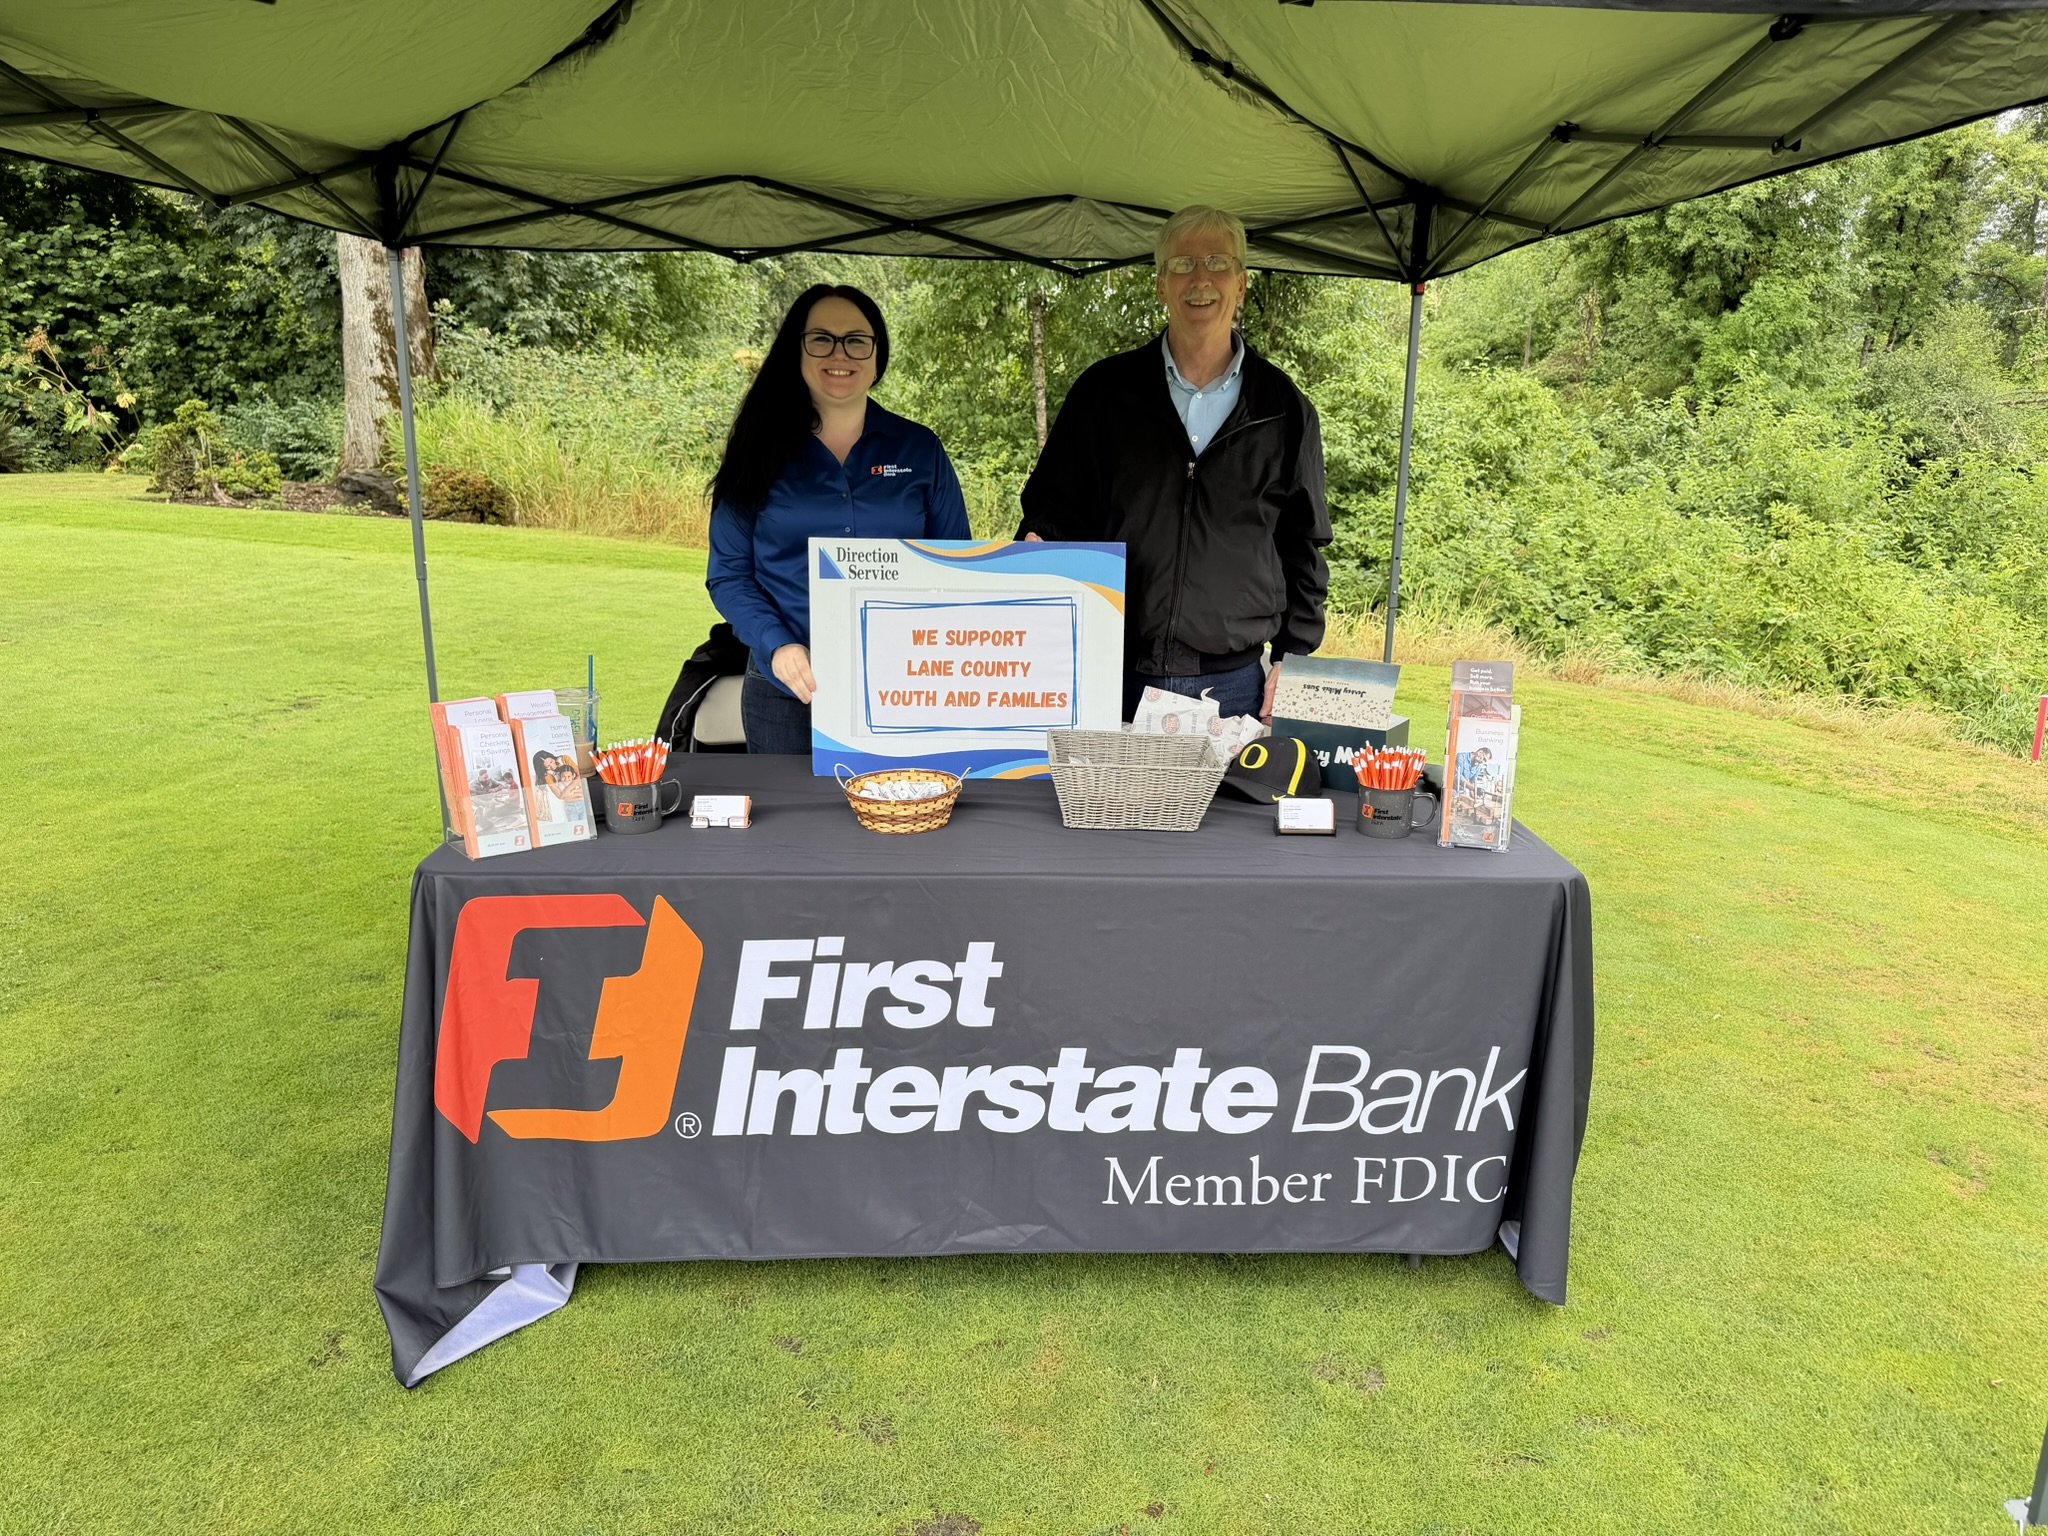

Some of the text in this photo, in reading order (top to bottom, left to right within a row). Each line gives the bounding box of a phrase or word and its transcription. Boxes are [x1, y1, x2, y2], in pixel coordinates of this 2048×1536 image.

[836, 547, 899, 563] Direction
[848, 564, 899, 581] Service
[912, 629, 1027, 647] WE SUPPORT
[907, 660, 1032, 677] LANE COUNTY
[878, 690, 1068, 708] YOUTH AND FAMILIES
[464, 709, 492, 717] Personal
[514, 709, 552, 717] Management
[480, 732, 508, 740] Personal
[1475, 728, 1504, 736] Business
[479, 739, 510, 748] Checking
[1478, 736, 1504, 745] Banking
[486, 747, 511, 756] Savings
[730, 936, 1003, 1030] First
[712, 1047, 1279, 1136] Interstate
[1292, 1045, 1527, 1135] Bank
[1102, 1154, 1332, 1206] Member
